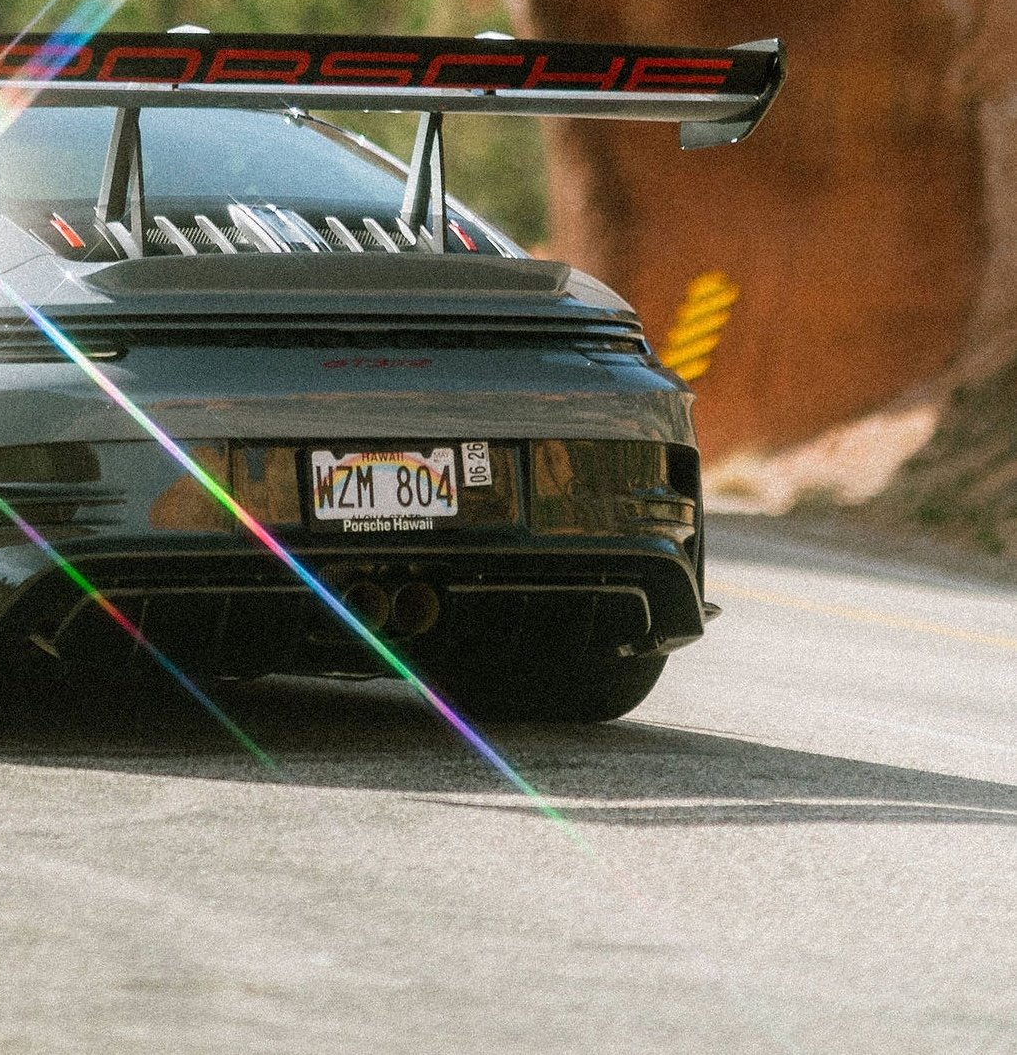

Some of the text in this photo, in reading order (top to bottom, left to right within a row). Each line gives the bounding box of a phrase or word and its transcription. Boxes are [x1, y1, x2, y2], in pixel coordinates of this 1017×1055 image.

[361, 452, 404, 462] HAWAII
[316, 465, 453, 508] WZM 804
[343, 519, 433, 532] Porsche Hawaii
